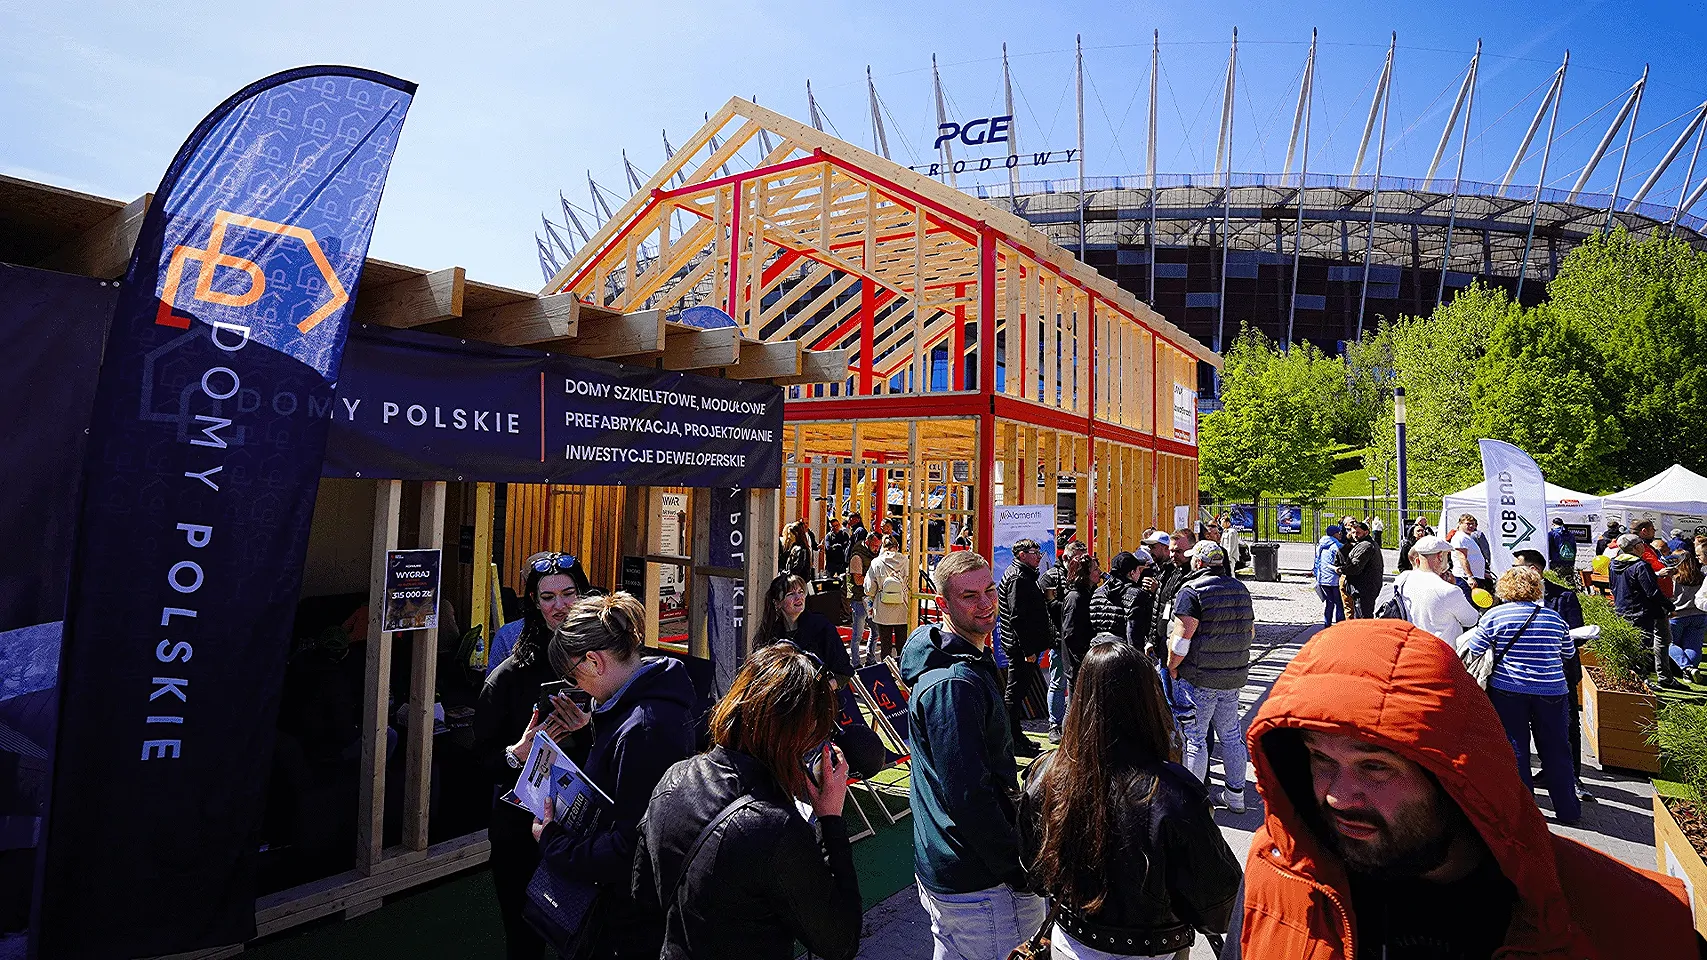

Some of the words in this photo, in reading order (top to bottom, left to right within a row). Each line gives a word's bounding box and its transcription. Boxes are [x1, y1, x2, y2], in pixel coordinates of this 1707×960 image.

[934, 115, 1013, 149] PGE
[908, 149, 1077, 177] RODOWY
[184, 320, 251, 492] DOMY
[565, 379, 610, 398] DOMY
[614, 386, 700, 411] SZKIELETOWE,
[701, 397, 766, 415] MODUŁOWE
[383, 401, 520, 434] POLSKIE
[565, 412, 682, 437] PREFABRYKACJA,
[684, 423, 773, 443] PROJEKTOWANIE
[565, 445, 654, 464] INWESTYCJE
[656, 451, 746, 468] DEWELOPERSKIE
[1499, 471, 1516, 505] BUD
[1502, 510, 1517, 538] ICB
[395, 570, 430, 578] WYGRAJ
[391, 592, 405, 600] 315
[405, 590, 421, 599] 000
[141, 522, 214, 761] POLSKIE
